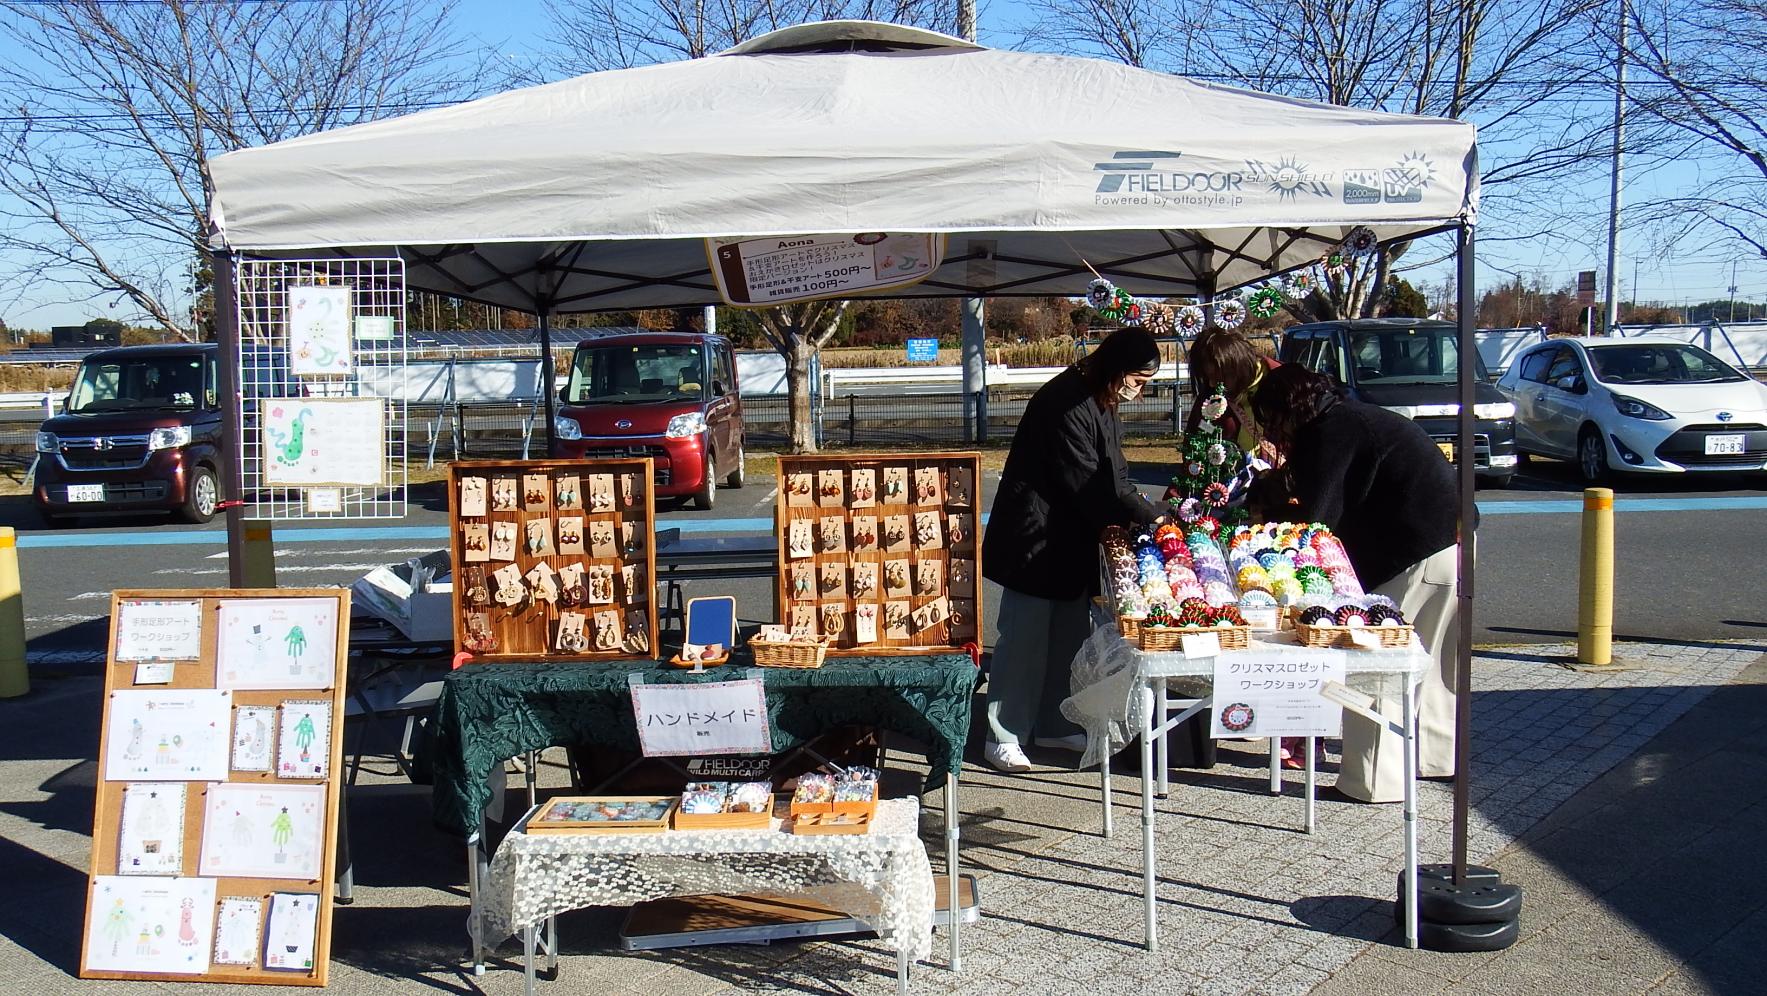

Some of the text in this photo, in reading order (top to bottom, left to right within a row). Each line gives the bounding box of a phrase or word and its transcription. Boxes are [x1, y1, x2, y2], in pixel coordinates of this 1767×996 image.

[1127, 172, 1243, 193] FIELDOOR
[1386, 183, 1410, 197] UV
[1095, 194, 1243, 207] Powered by ottostyle.jp
[777, 239, 814, 249] Aona
[723, 250, 732, 259] 5
[130, 632, 191, 642] ワークショップ
[1230, 661, 1331, 674] クリスマスロゼット
[1239, 679, 1319, 690] ワークショップ
[647, 709, 756, 727] ハンドメイド
[704, 758, 770, 770] FIELDOOR
